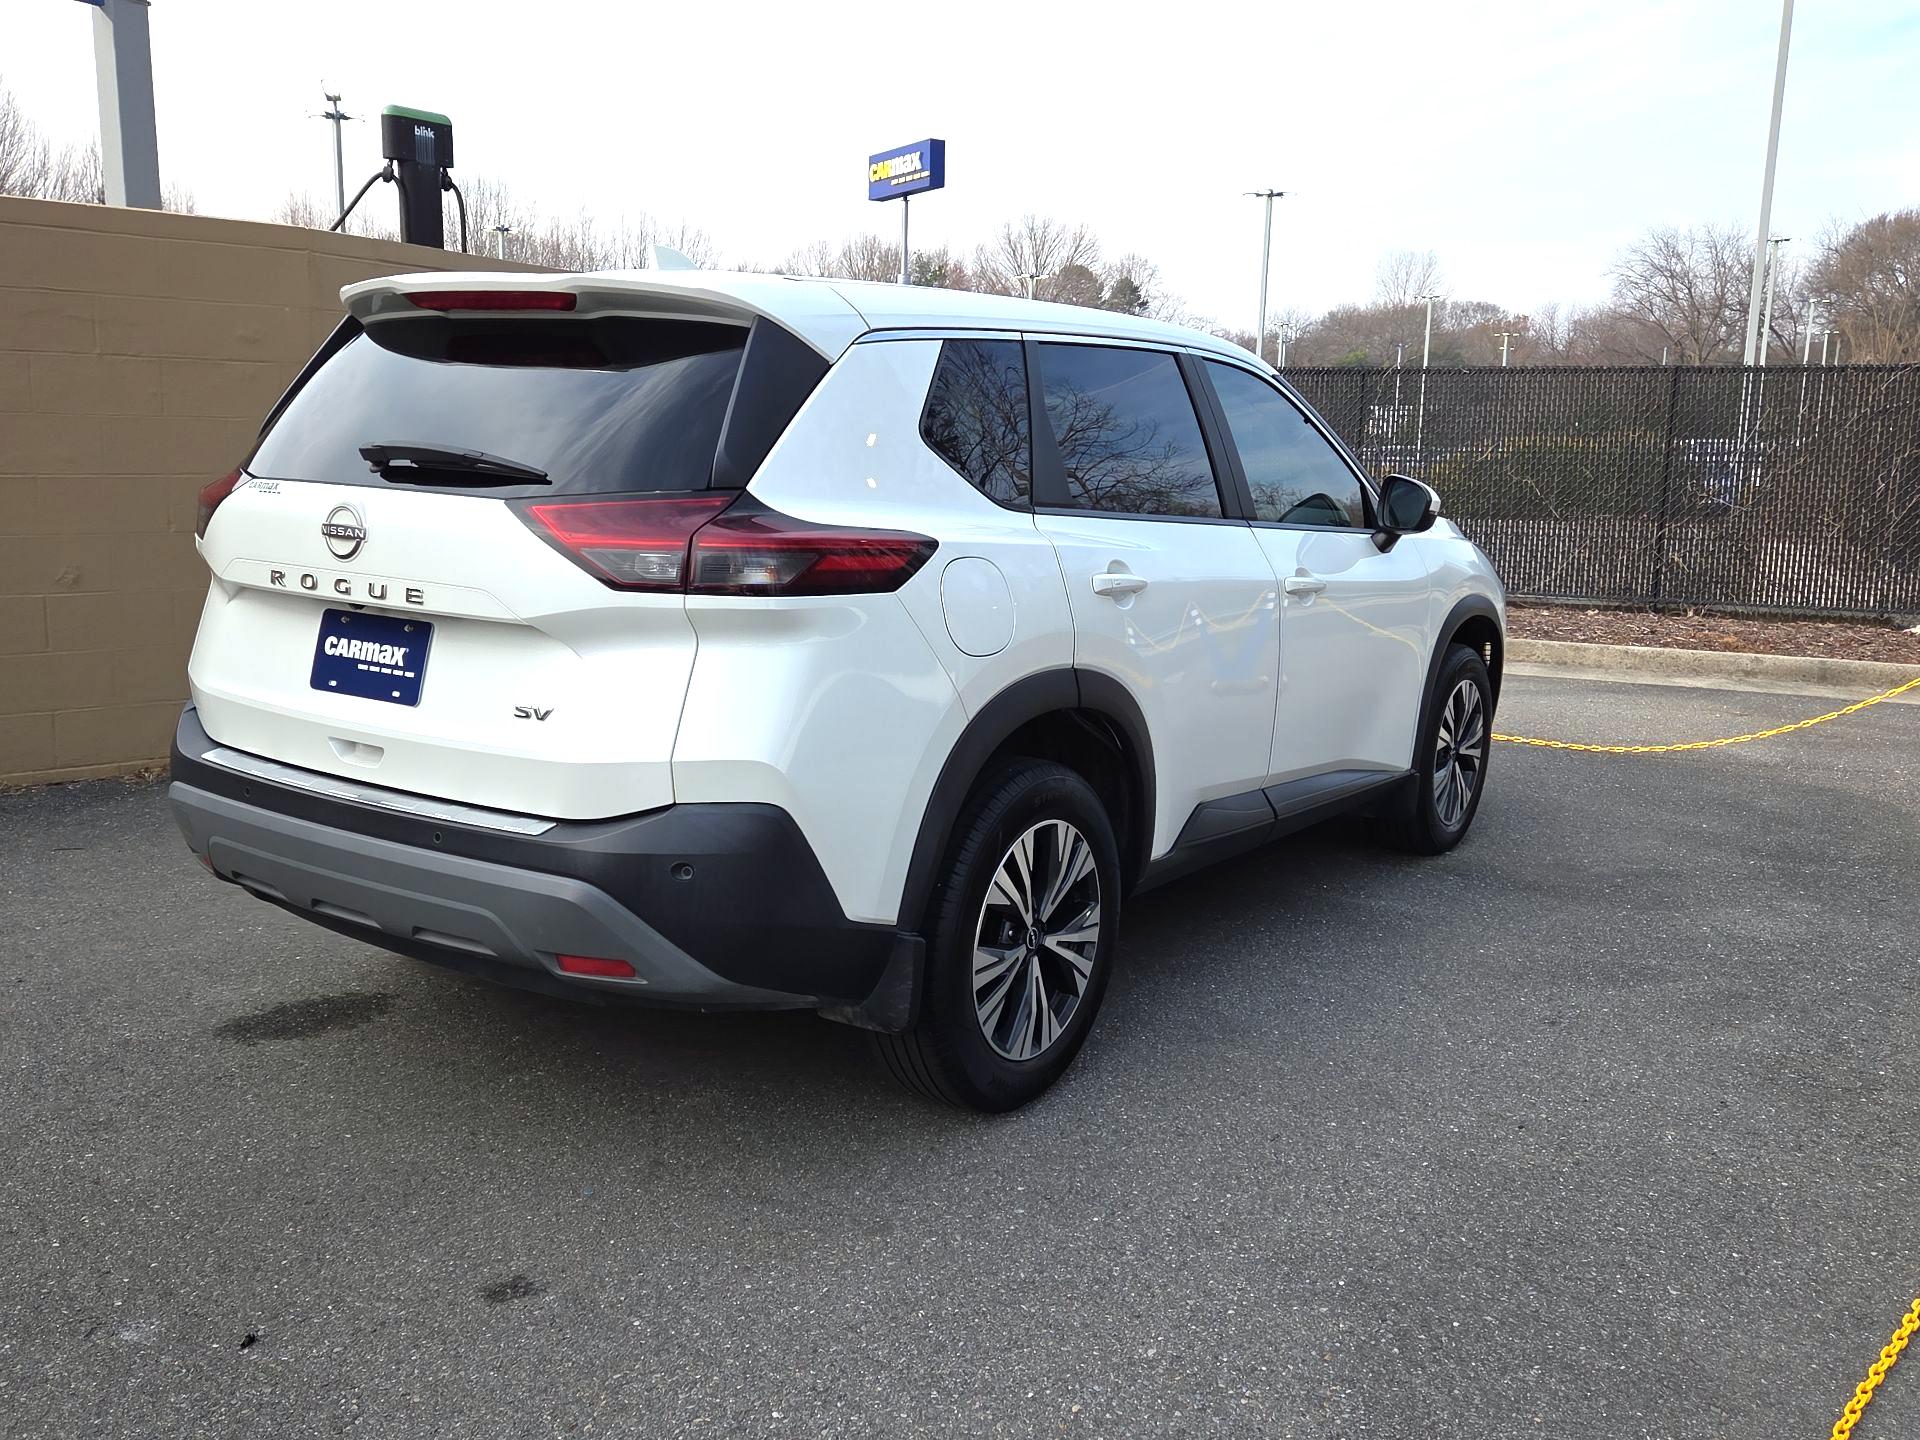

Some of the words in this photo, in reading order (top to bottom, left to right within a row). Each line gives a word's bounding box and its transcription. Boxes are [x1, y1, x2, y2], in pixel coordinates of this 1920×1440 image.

[414, 125, 435, 138] blink
[322, 525, 364, 538] NISSAN
[270, 570, 424, 605] ROGUE
[513, 705, 554, 721] SV
